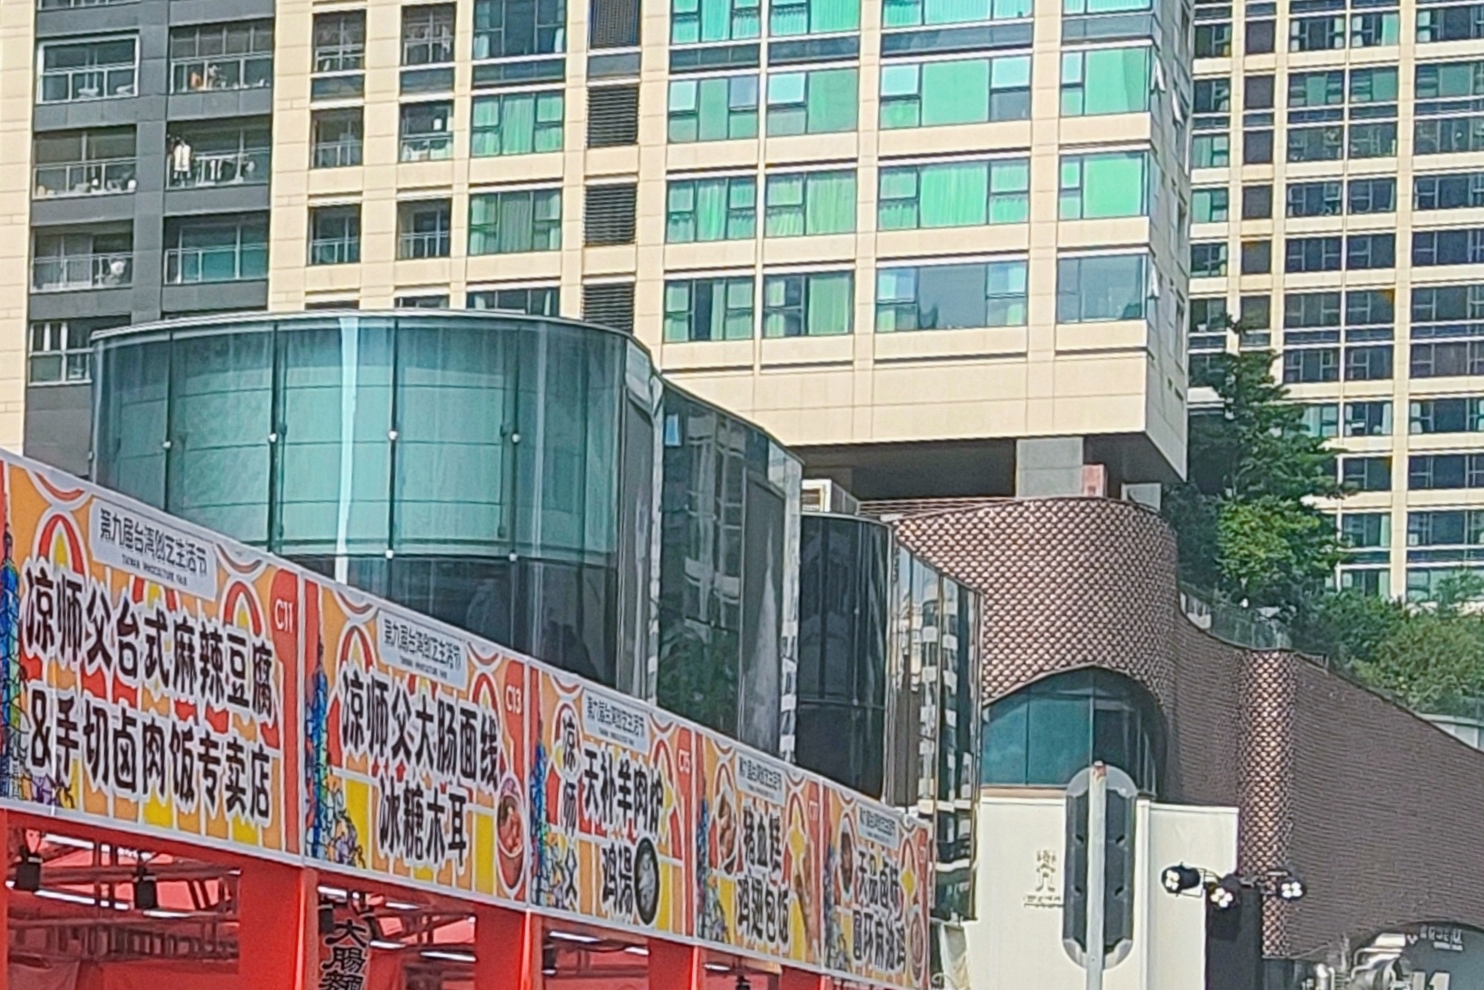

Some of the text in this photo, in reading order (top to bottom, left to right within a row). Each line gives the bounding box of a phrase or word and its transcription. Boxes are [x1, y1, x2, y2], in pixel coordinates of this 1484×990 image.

[25, 566, 274, 719] 凉师父台式麻辣豆腐
[275, 600, 294, 632] C11
[505, 684, 522, 714] C13
[30, 690, 272, 819] &手切卤肉饭专卖店
[379, 776, 468, 869] 冰糖木耳
